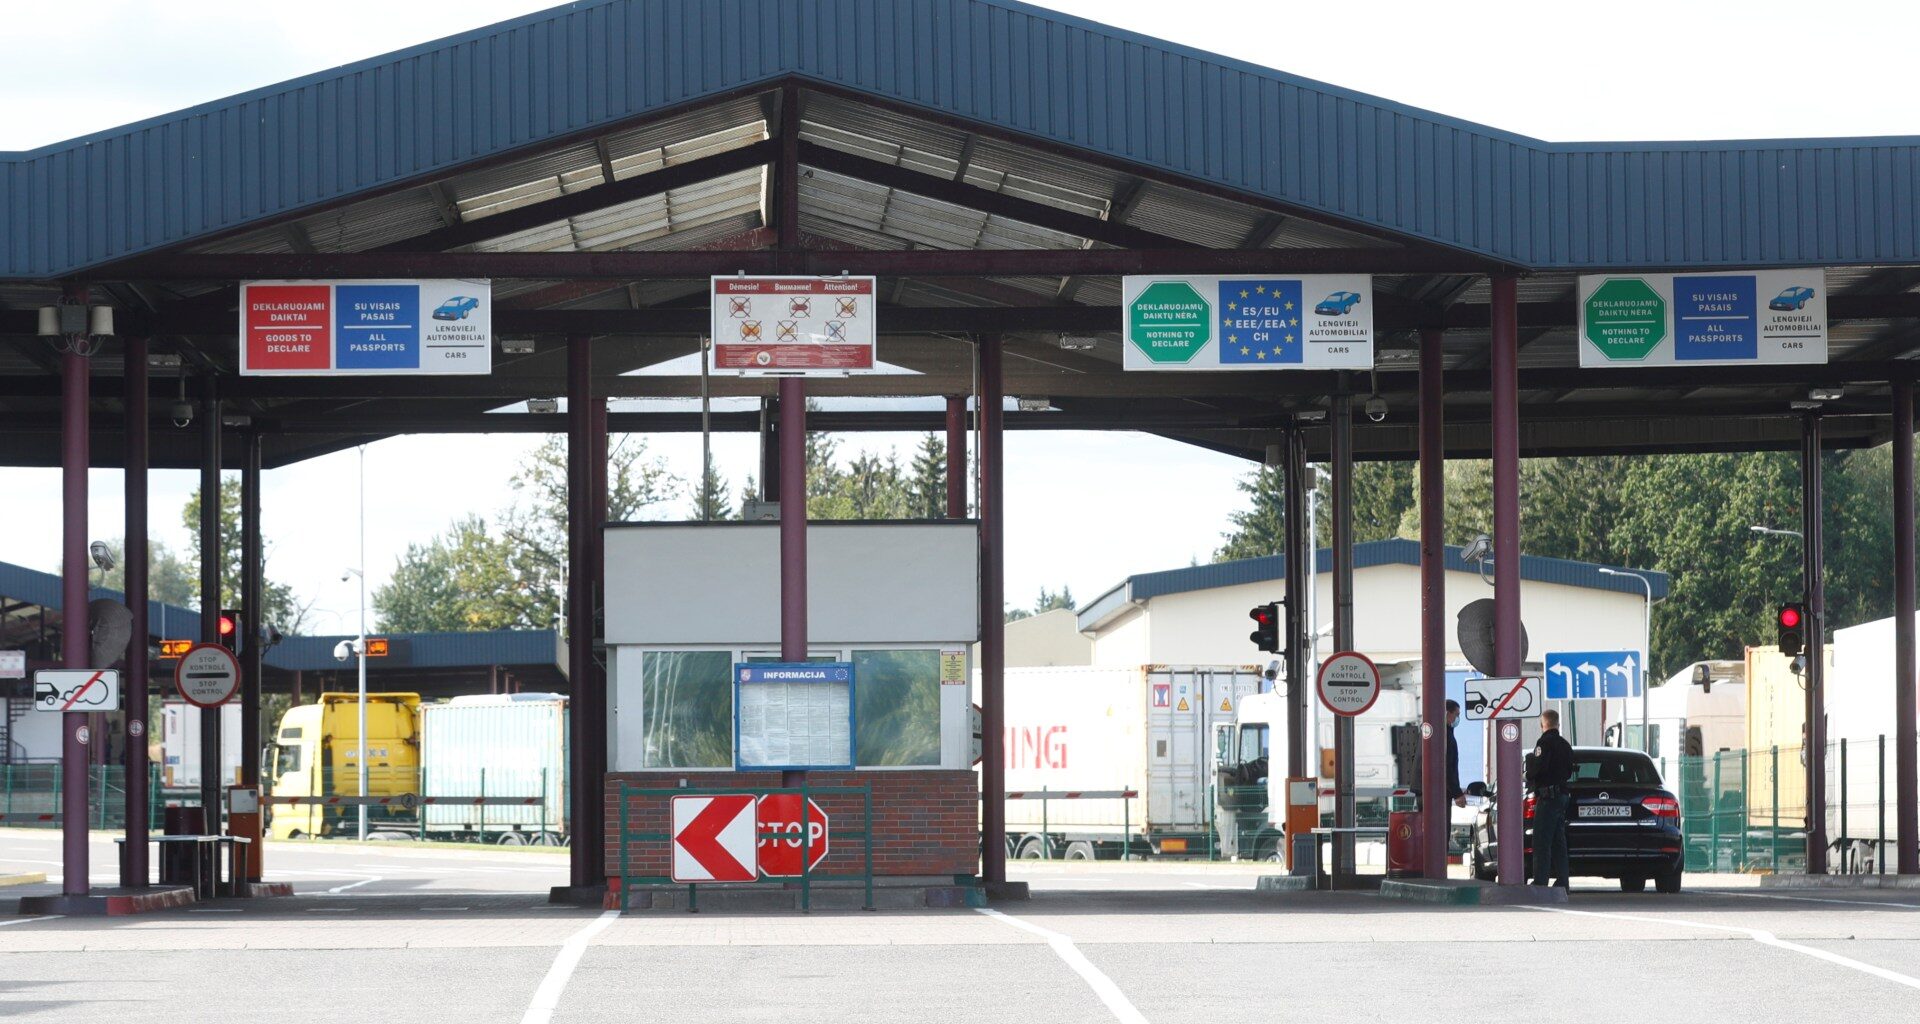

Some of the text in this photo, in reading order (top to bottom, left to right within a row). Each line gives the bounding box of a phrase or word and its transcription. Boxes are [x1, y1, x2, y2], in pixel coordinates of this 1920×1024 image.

[775, 283, 812, 291] Внимание!
[824, 283, 858, 291] Attention!
[1692, 293, 1738, 302] SU VISAIS
[253, 303, 325, 311] DEKLARUOJAMI
[355, 303, 400, 311] SU VISAIS
[1699, 304, 1732, 312] PASAIS
[1242, 307, 1279, 316] ES/EU
[1599, 308, 1628, 317] DAIKTŲ
[270, 313, 307, 321] DAIKTAI
[361, 313, 394, 321] PASAIS
[1143, 311, 1197, 321] DAIKTŲ NĖRA
[1236, 319, 1287, 329] EEE/EEA
[1707, 324, 1724, 332] ALL
[1764, 324, 1822, 332] AUTOMOBILIAI
[1147, 331, 1183, 339] NOTHING
[1602, 328, 1638, 336] NOTHING
[265, 334, 312, 342] GOODS TO
[1253, 332, 1269, 342] CH
[1608, 337, 1645, 345] DECLARE
[1689, 334, 1743, 343] PASSPORTS
[350, 343, 406, 352] PASSPORTS
[1152, 340, 1190, 348] DECLARE
[268, 345, 310, 353] DECLARE
[1001, 725, 1068, 769] ING
